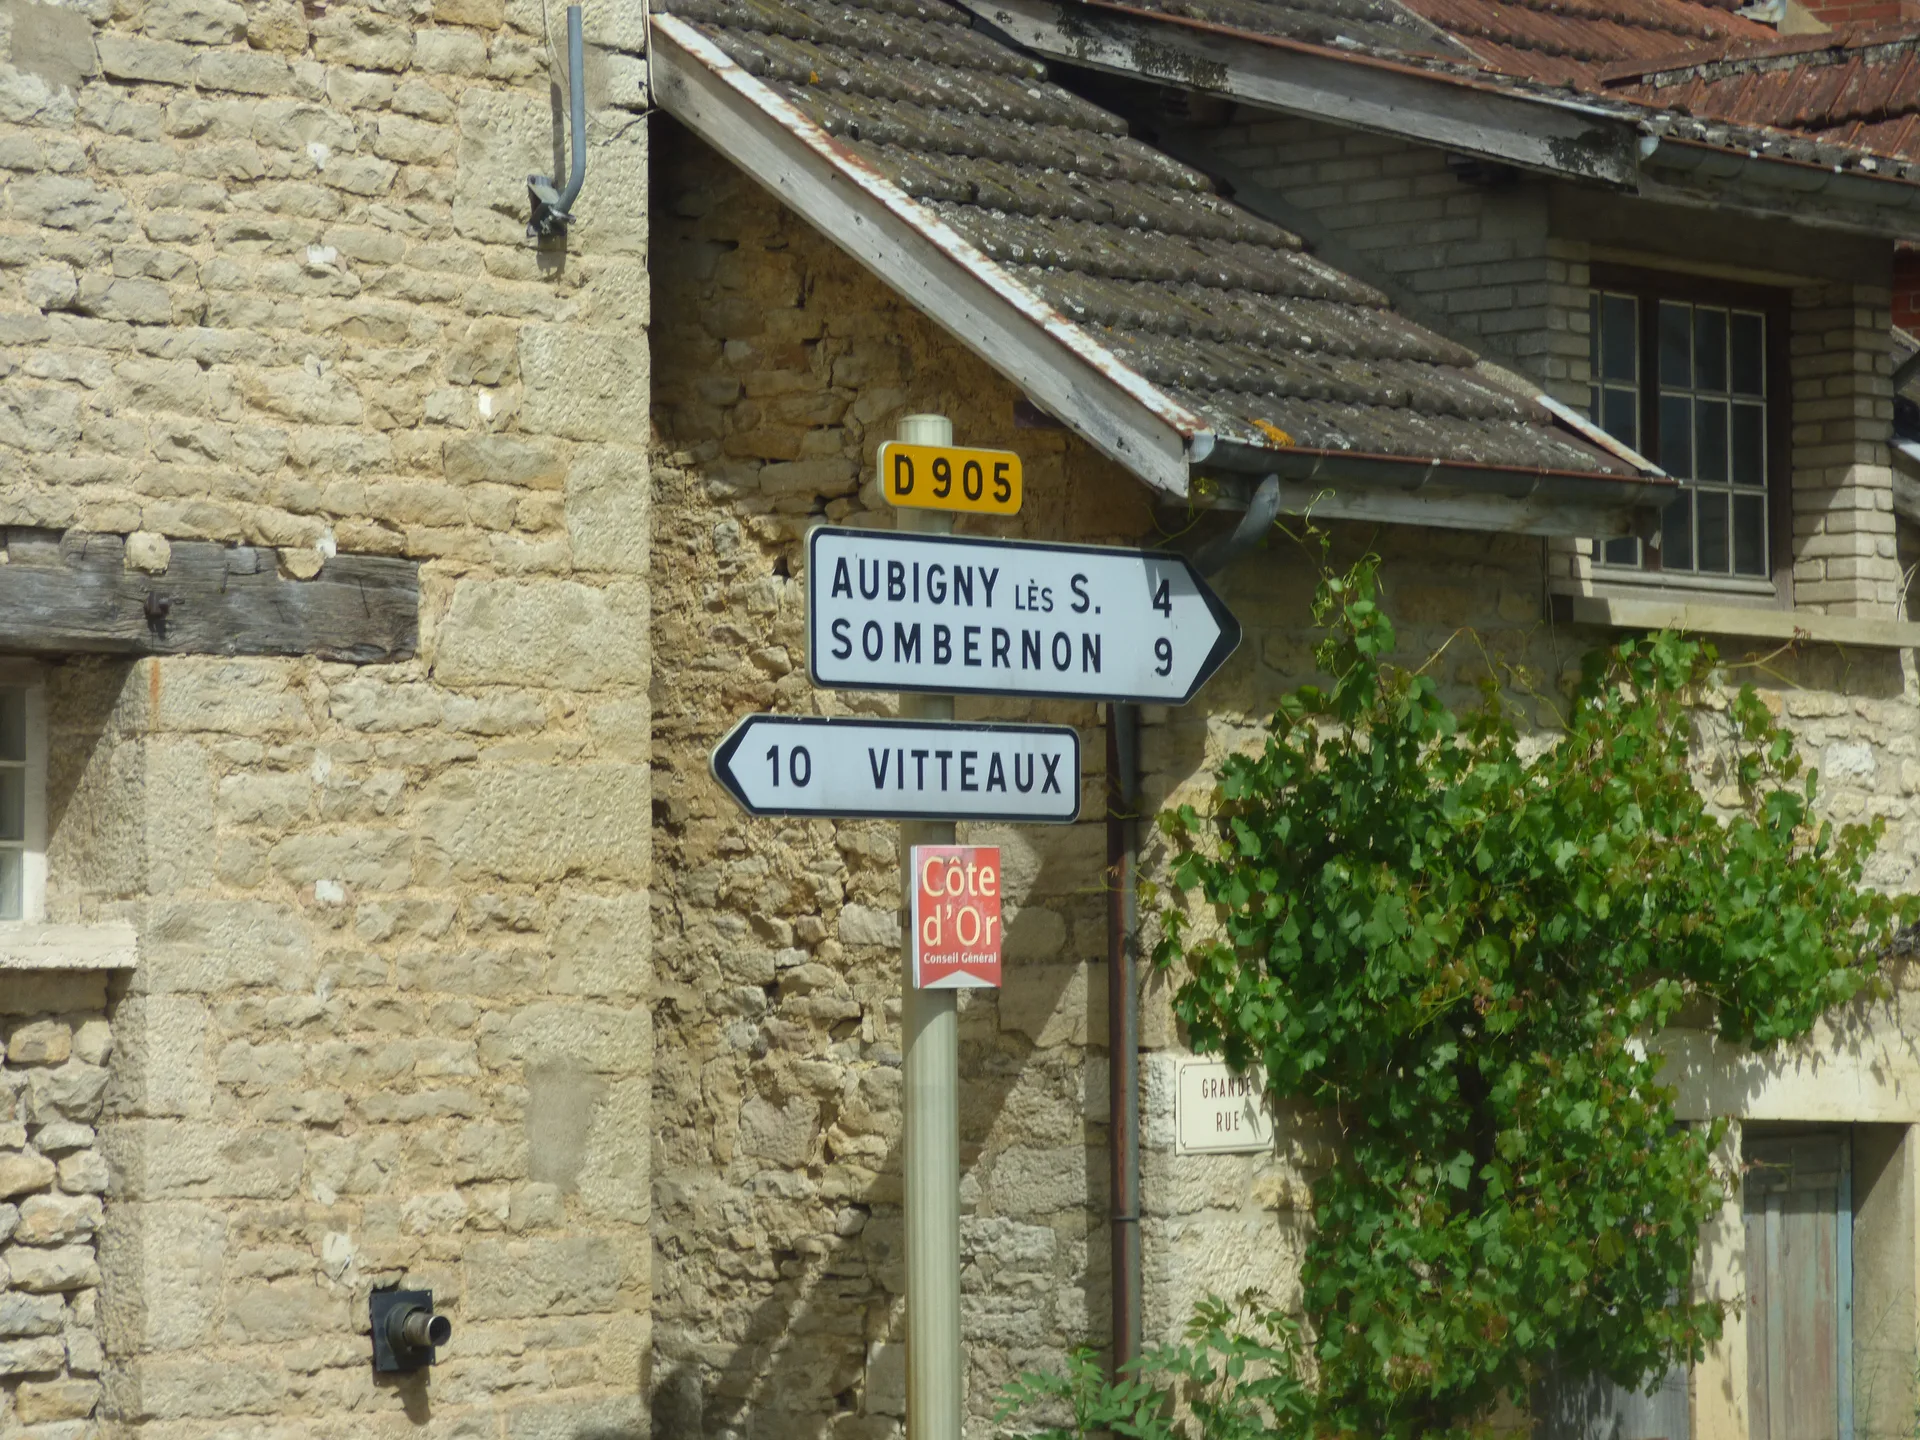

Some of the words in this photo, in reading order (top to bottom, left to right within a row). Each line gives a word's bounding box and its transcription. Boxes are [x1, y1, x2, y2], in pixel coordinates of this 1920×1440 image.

[894, 454, 914, 496] D
[931, 459, 1012, 503] 905
[831, 556, 1000, 609] AUBIGNY
[1015, 578, 1054, 613] LÈS
[1070, 573, 1101, 615] S.
[1152, 578, 1173, 618] 4
[831, 618, 1101, 674] SOMBERNON
[1154, 637, 1173, 677] 9
[766, 744, 812, 788] 10
[868, 747, 1062, 794] VITTEAUX
[922, 855, 996, 897] Côte
[923, 904, 998, 947] d'Or
[924, 952, 959, 964] Conseil
[961, 951, 997, 964] Général
[1202, 1076, 1252, 1099] GRANDE
[1216, 1111, 1240, 1132] RUE
